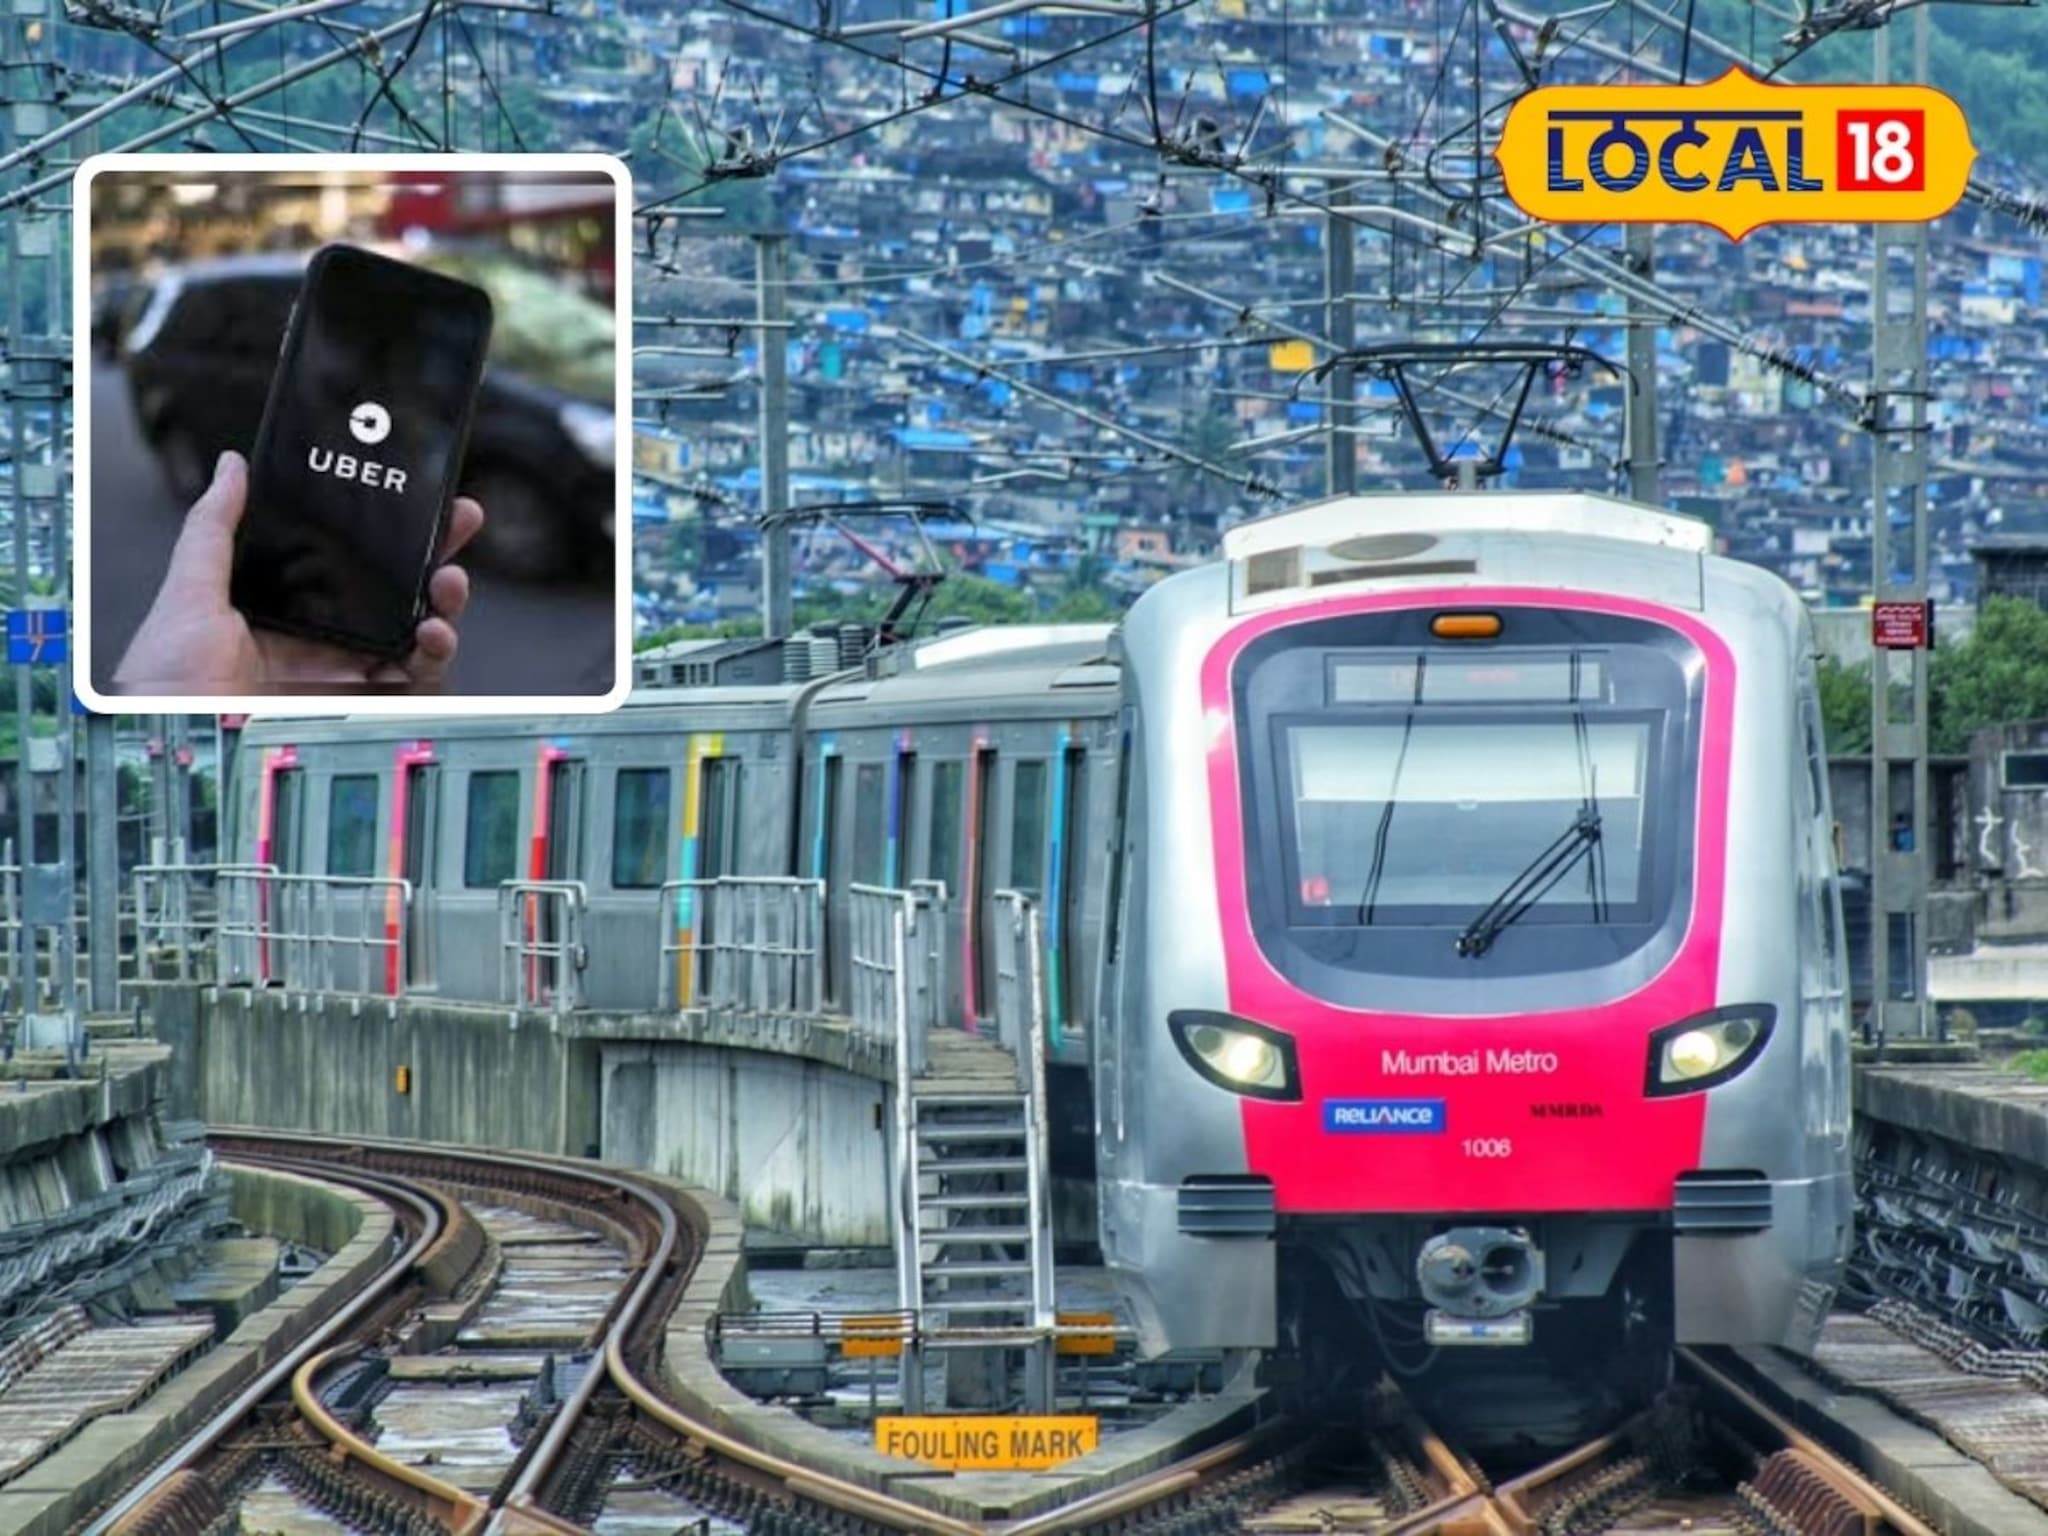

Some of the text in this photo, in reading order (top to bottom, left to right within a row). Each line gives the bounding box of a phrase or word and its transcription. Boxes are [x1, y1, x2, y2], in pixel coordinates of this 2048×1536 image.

[308, 446, 408, 494] UBER
[1381, 1049, 1558, 1075] Mumbai Metro
[1462, 1138, 1512, 1158] 1006
[887, 1430, 1084, 1459] FOULING MARK
